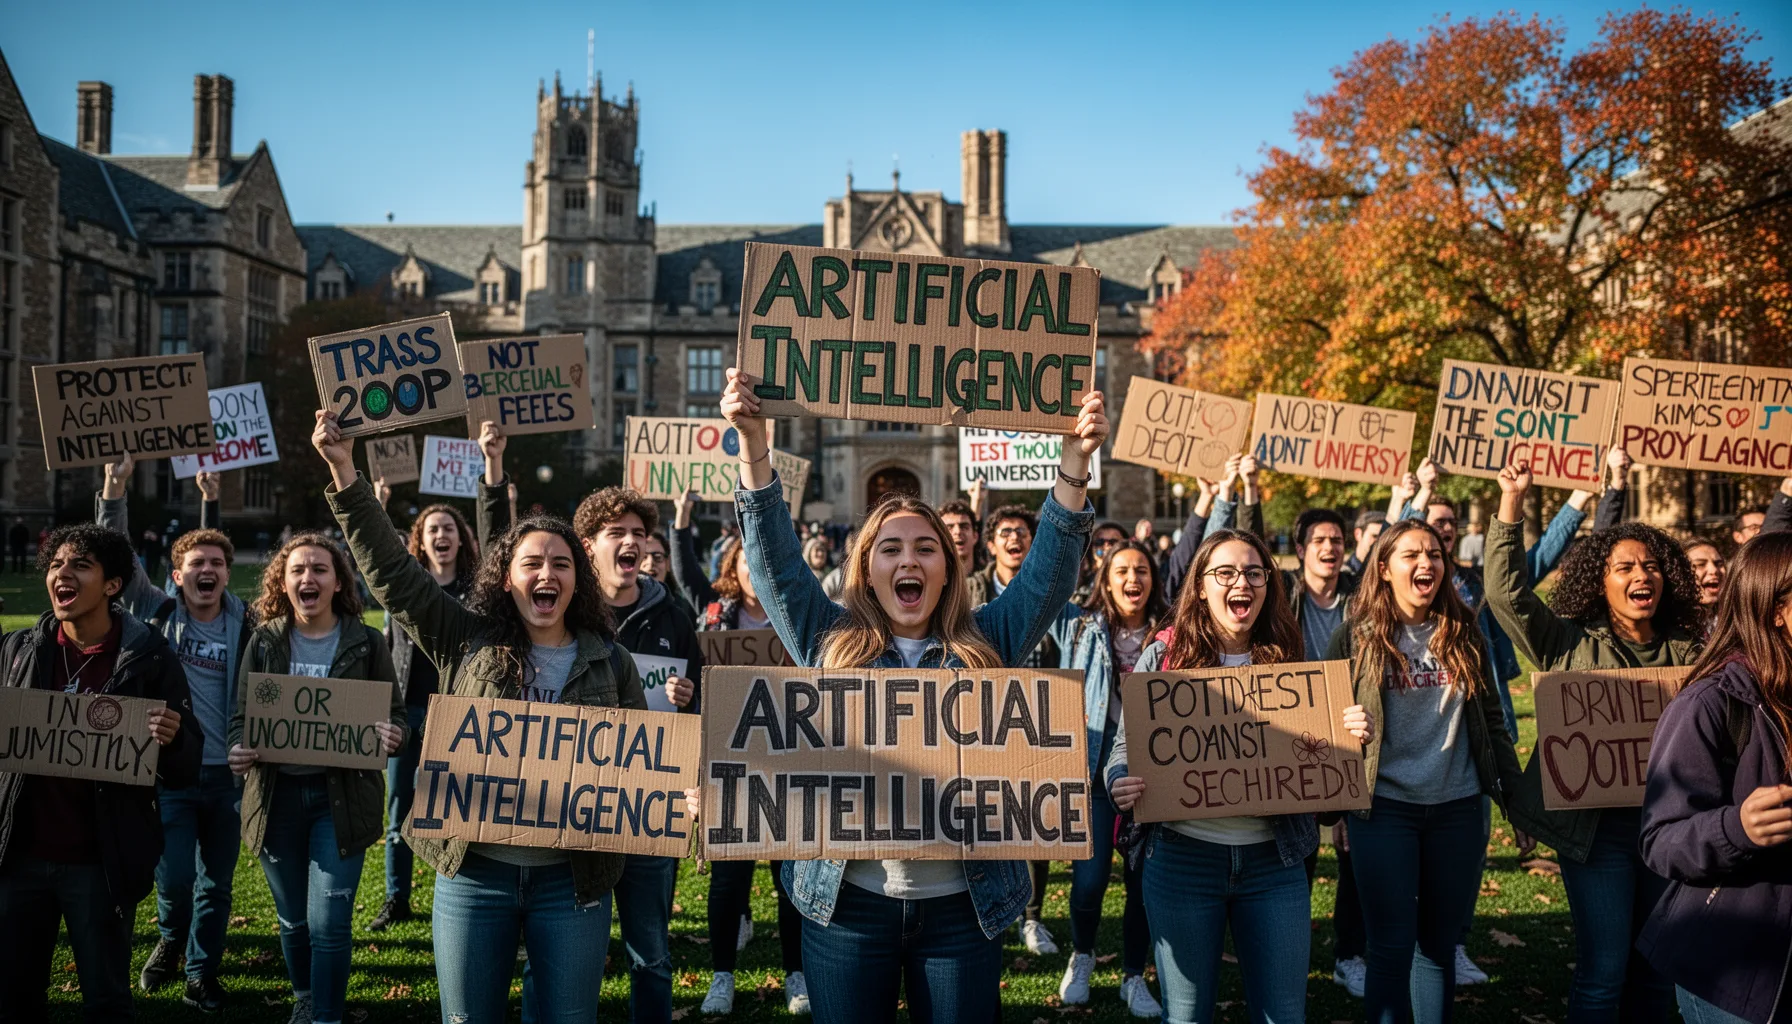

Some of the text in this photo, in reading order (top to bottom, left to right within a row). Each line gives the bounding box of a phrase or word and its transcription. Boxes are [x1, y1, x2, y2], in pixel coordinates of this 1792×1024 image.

[752, 250, 1091, 336] ARTIFICIAL
[320, 326, 441, 381] TRASS
[488, 341, 539, 369] NOT
[751, 325, 1092, 416] INTELLIGENCE
[56, 362, 196, 400] PROTECT
[61, 396, 172, 431] AGAINST
[499, 393, 575, 425] FEEES
[1442, 403, 1488, 438] THE
[57, 423, 211, 462] INTELLIGENCE
[970, 442, 1010, 462] TEST
[1623, 425, 1697, 460] PROY
[47, 695, 80, 728] IN
[295, 686, 331, 716] OR
[729, 678, 1073, 750] ARTIFICIAL
[448, 704, 681, 774] ARTIFICIAL
[413, 760, 687, 839] INTELLIGENCE
[708, 762, 1087, 852] INTELLIGENCE
